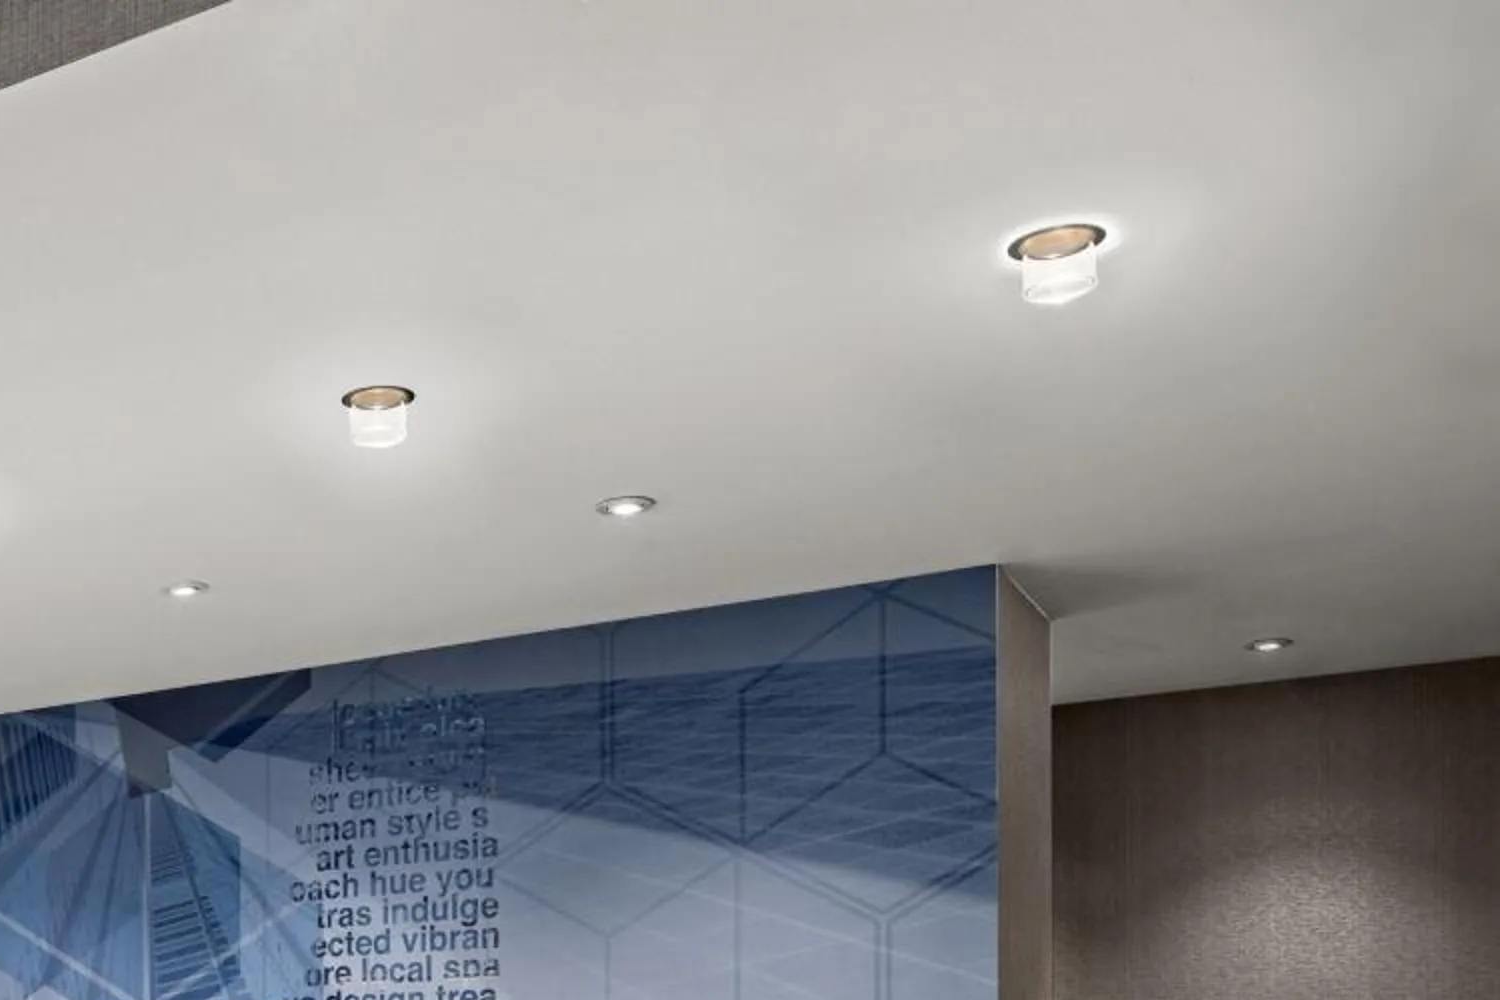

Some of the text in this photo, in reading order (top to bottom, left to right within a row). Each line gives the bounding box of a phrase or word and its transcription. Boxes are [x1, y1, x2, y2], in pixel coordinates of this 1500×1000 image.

[349, 776, 440, 811] entice
[387, 805, 461, 838] style
[316, 832, 499, 872] art enthusia
[370, 870, 427, 898] hue
[436, 867, 494, 897] you
[316, 893, 499, 929] tras indulge
[311, 926, 499, 958] ected vibran
[361, 956, 432, 983] local
